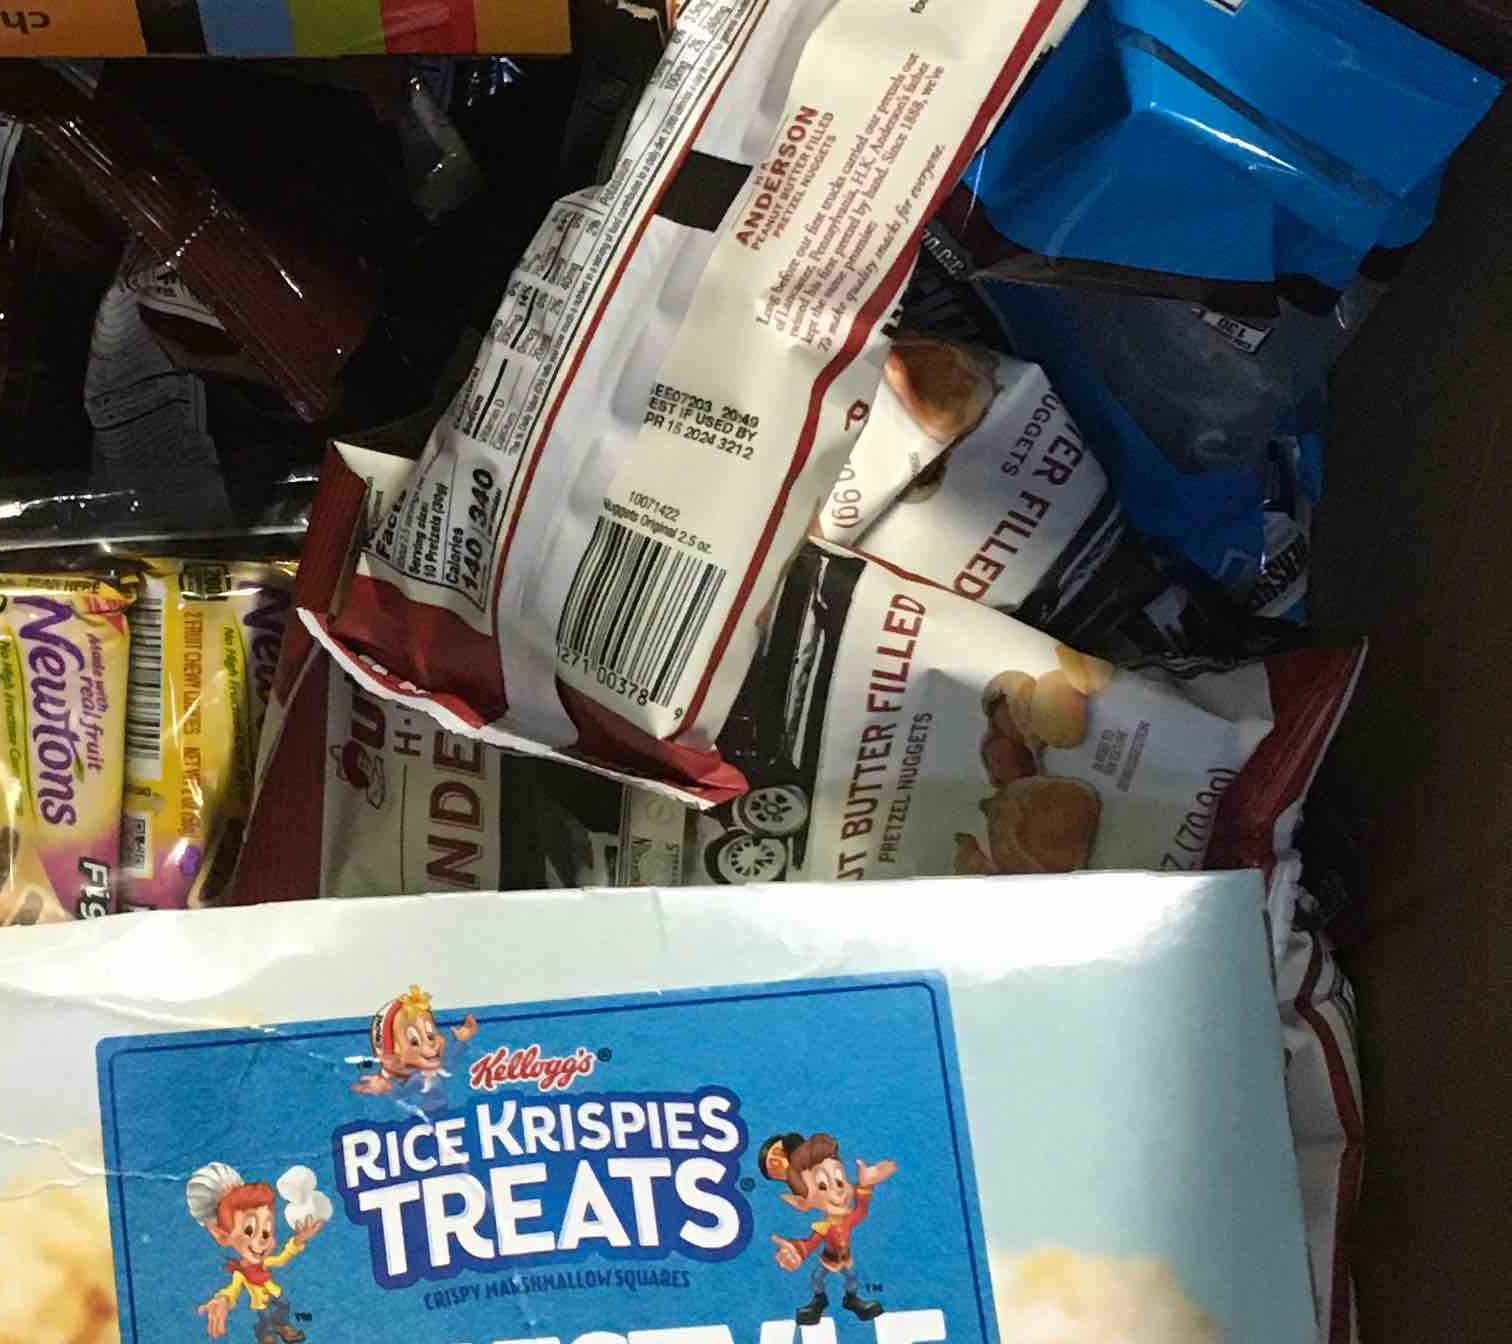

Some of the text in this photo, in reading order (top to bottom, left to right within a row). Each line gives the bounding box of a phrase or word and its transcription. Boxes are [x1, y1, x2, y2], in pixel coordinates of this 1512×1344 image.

[737, 102, 818, 247] ANDERSON
[776, 108, 835, 201] BUTTER FILLED
[683, 424, 756, 461] 2024 3212
[694, 411, 758, 443] USED BY
[720, 405, 760, 428] 20:49
[463, 467, 496, 527] 340
[625, 489, 683, 524] 10071422
[443, 525, 467, 585] Calories
[952, 489, 1051, 601] FILLED
[85, 632, 106, 679] Made
[13, 598, 85, 825] Newtons
[591, 665, 653, 707] 00378
[840, 592, 925, 836] BUTTER FILLED
[77, 675, 106, 775] real fruit
[876, 709, 934, 865] PRETZEL NUGGETS
[467, 1041, 596, 1097] Kellogg's
[340, 1083, 739, 1188] RICE KRISPIES
[357, 1149, 742, 1279] TREATS
[423, 1264, 691, 1310] CRISPY SQUARES
